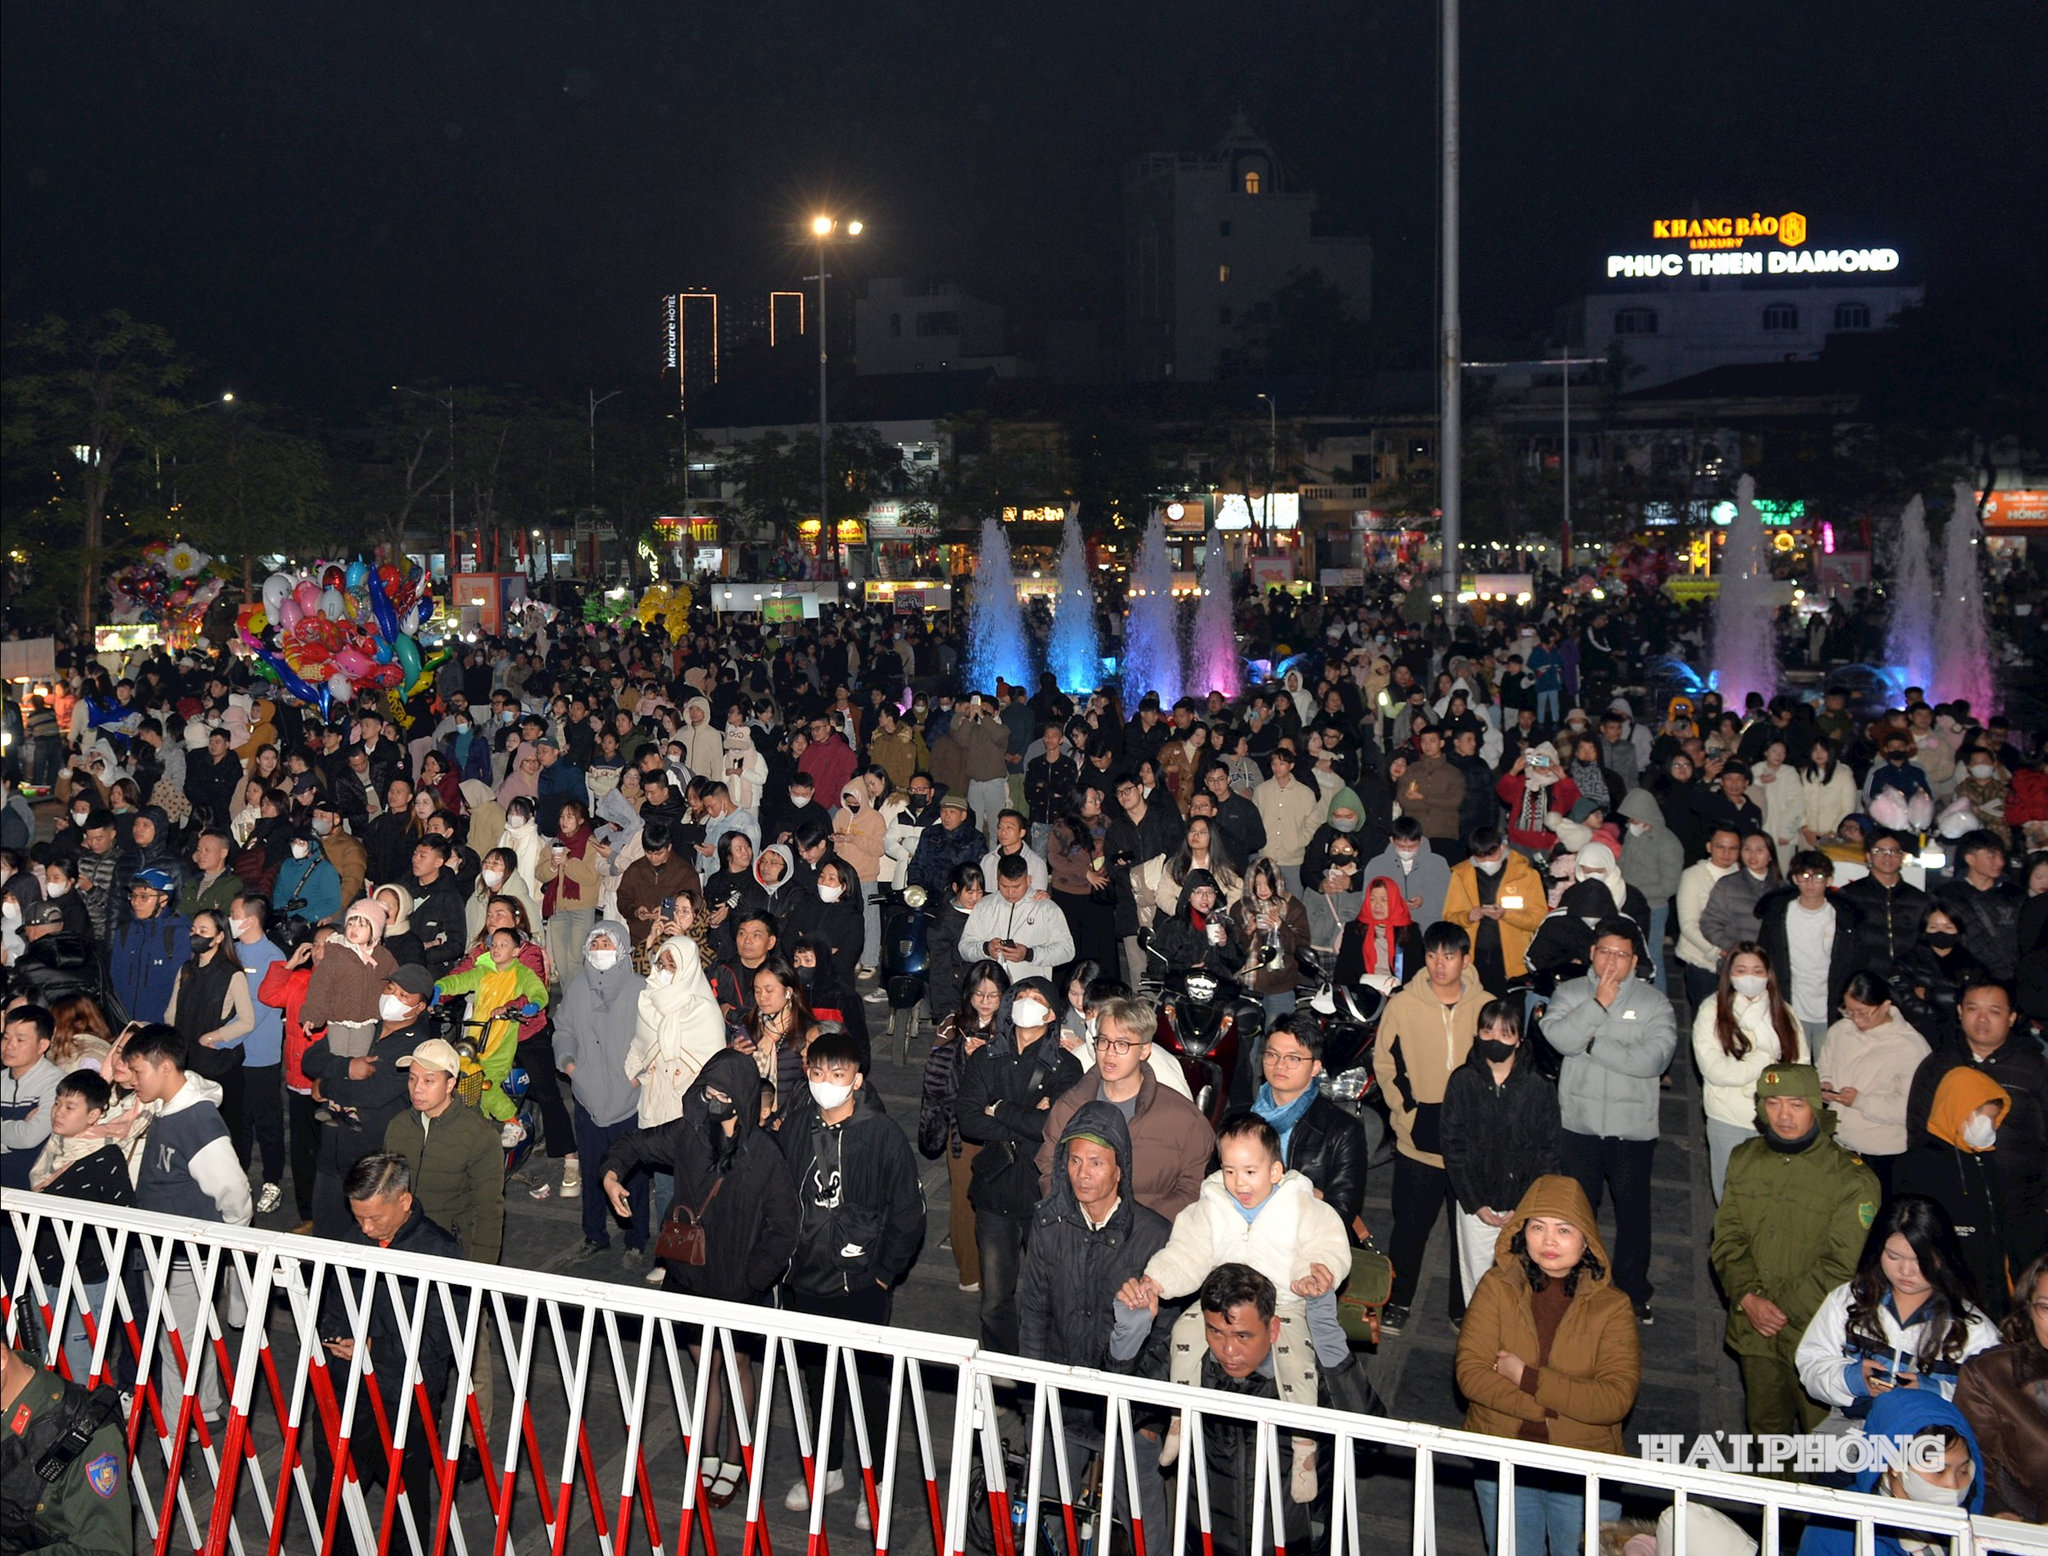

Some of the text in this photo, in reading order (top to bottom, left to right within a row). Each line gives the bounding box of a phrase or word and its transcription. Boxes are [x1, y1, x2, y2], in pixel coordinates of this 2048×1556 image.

[1652, 211, 1779, 239] KHANG BẢO
[1689, 238, 1744, 249] LUXURY
[1607, 248, 1900, 279] PHUC THIEN DIAMOND
[668, 294, 677, 367] Mercure HOTEL
[156, 1144, 176, 1173] N
